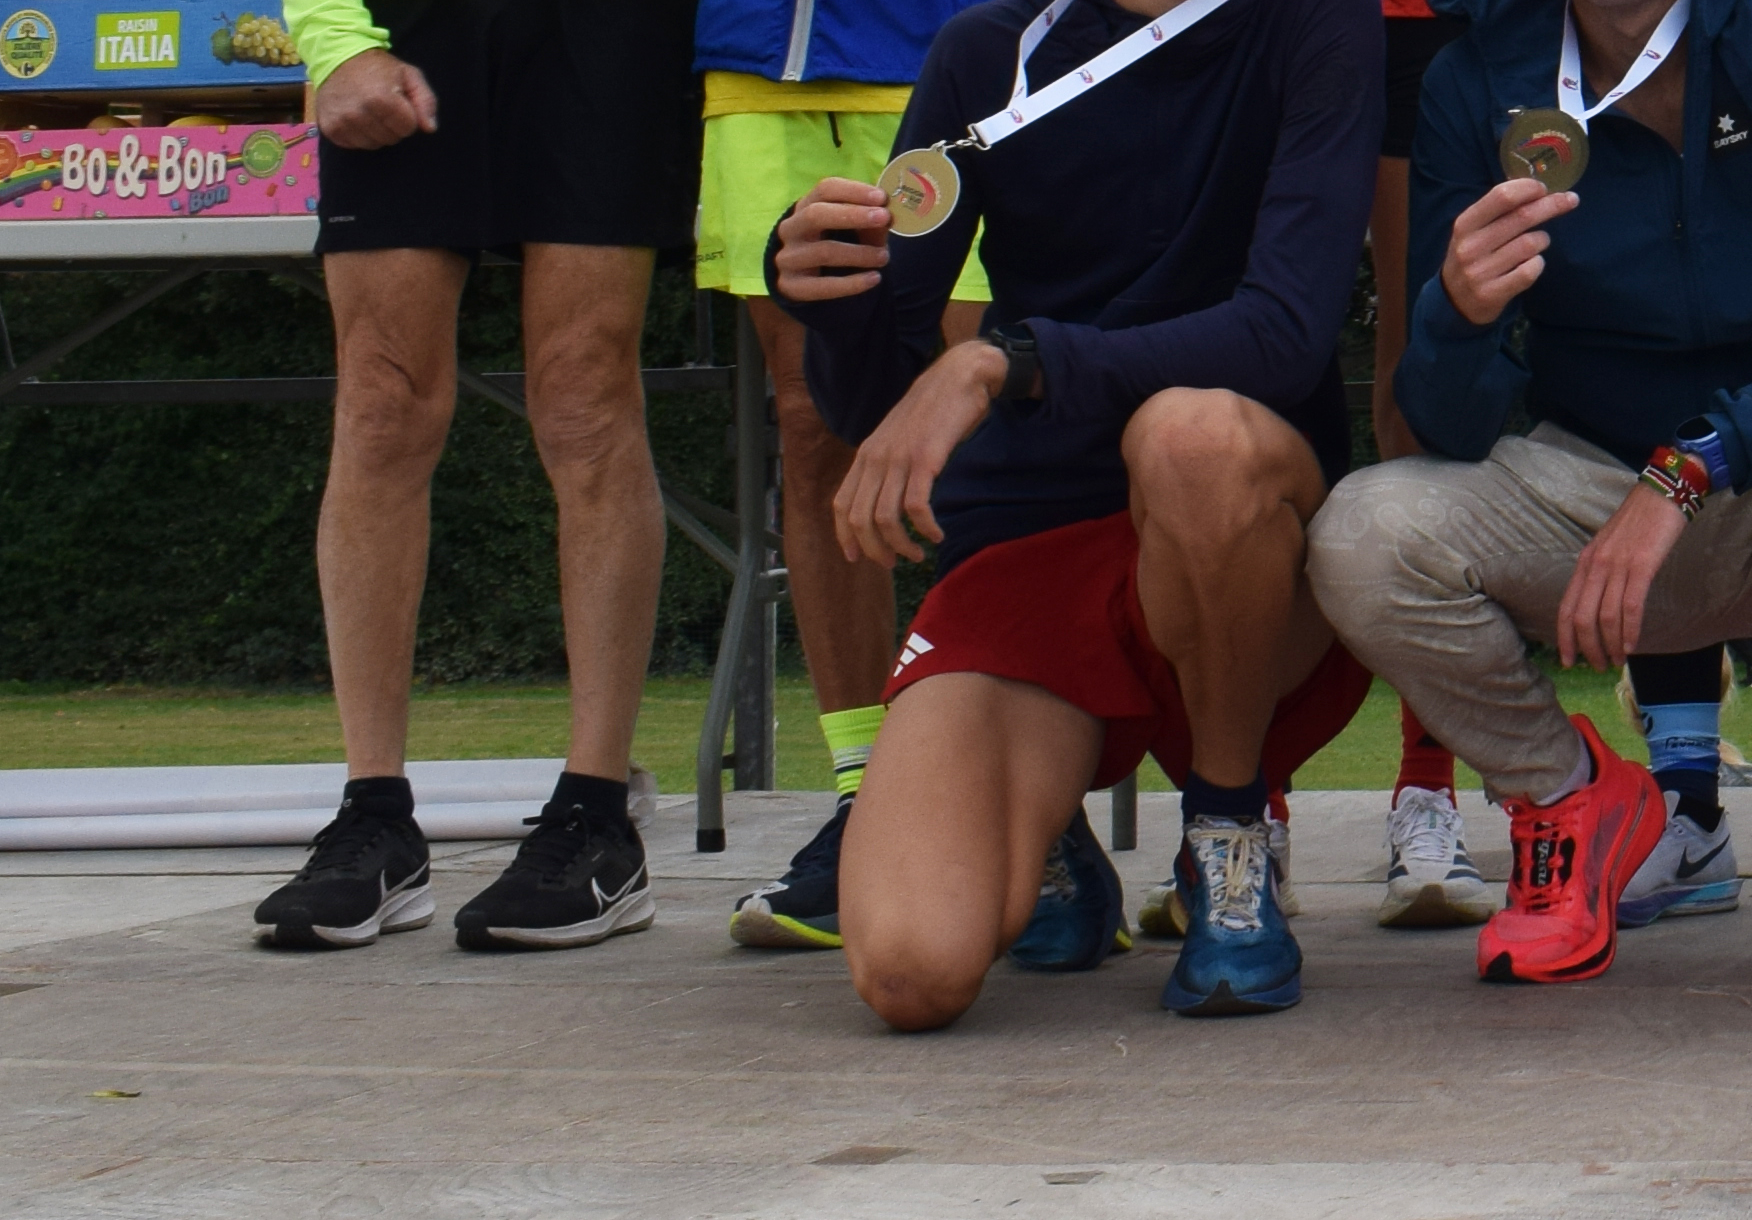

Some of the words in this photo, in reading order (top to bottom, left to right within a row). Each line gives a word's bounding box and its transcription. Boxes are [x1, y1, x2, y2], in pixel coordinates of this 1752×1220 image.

[117, 18, 158, 32] RAISIN
[98, 34, 176, 64] ITALIA
[62, 143, 108, 196] Bo
[114, 134, 149, 199] &
[158, 135, 227, 196] Bon
